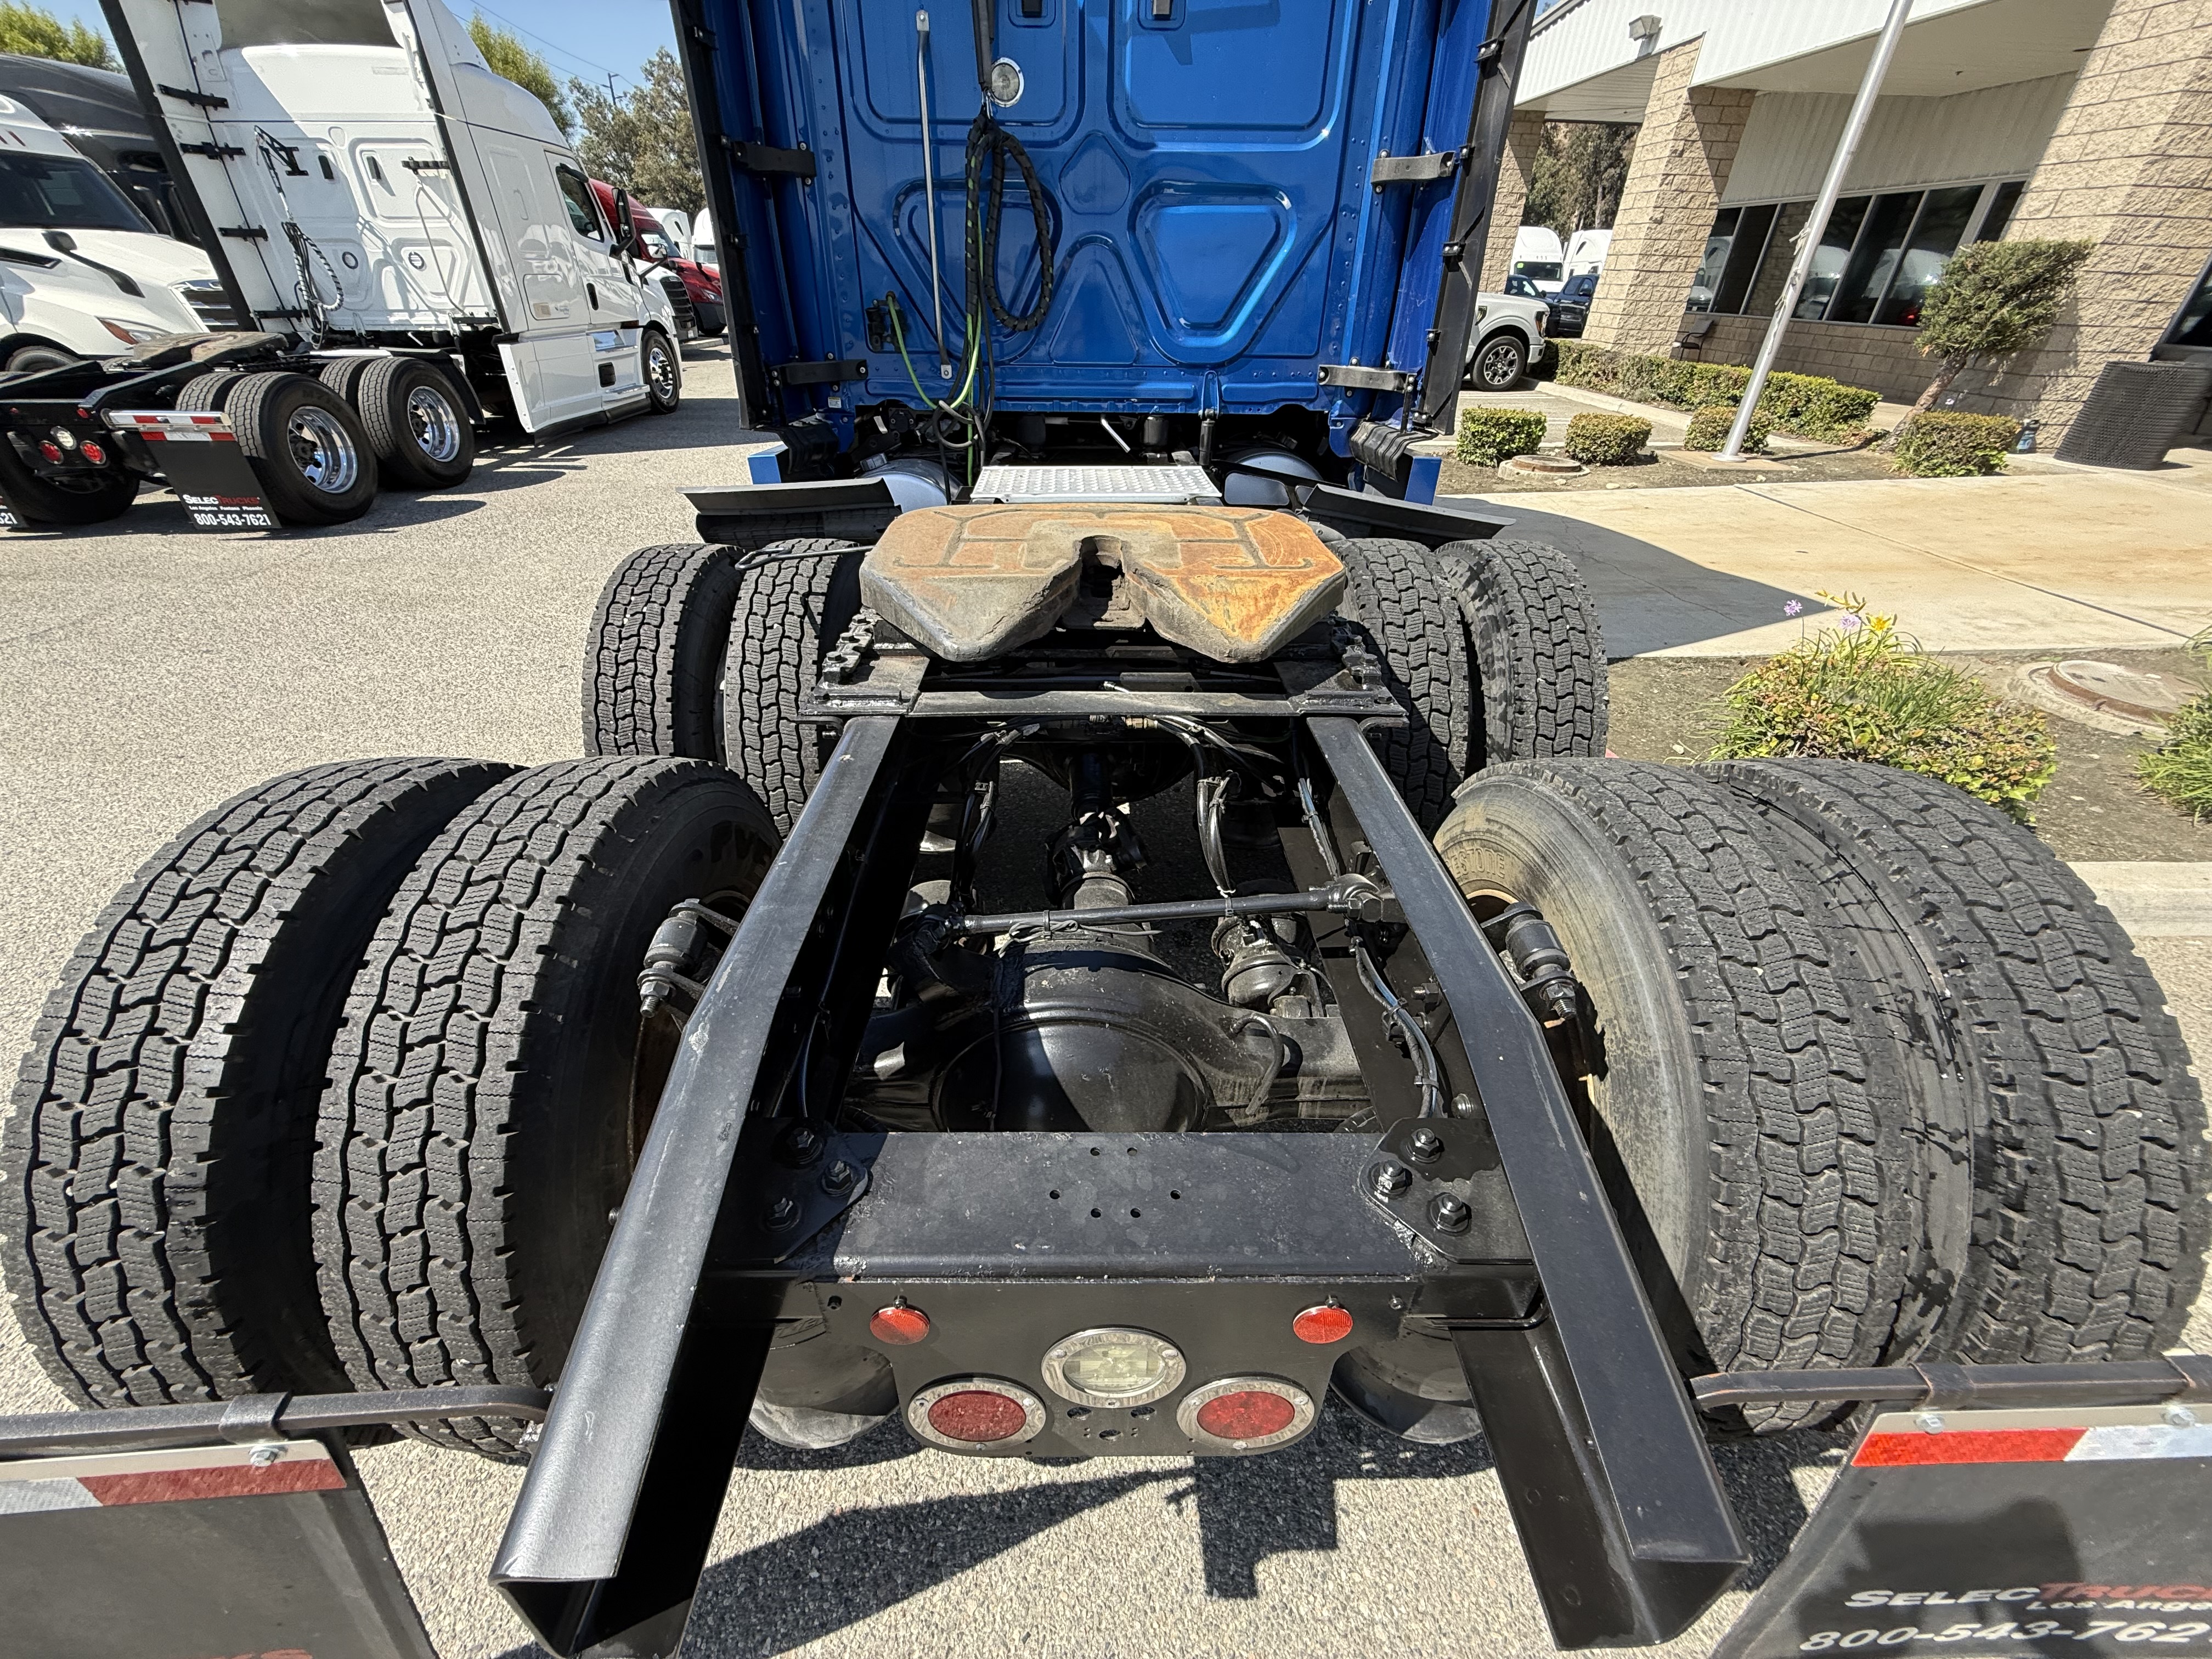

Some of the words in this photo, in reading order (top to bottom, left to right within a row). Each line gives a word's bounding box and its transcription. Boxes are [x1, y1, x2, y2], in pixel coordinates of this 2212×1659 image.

[194, 514, 272, 526] 800-543-7621
[1844, 1582, 2212, 1607] SELECTRUC
[2026, 1601, 2097, 1610] Los
[2103, 1600, 2212, 1612] Ange
[1799, 1620, 2212, 1651] 800-543-762
